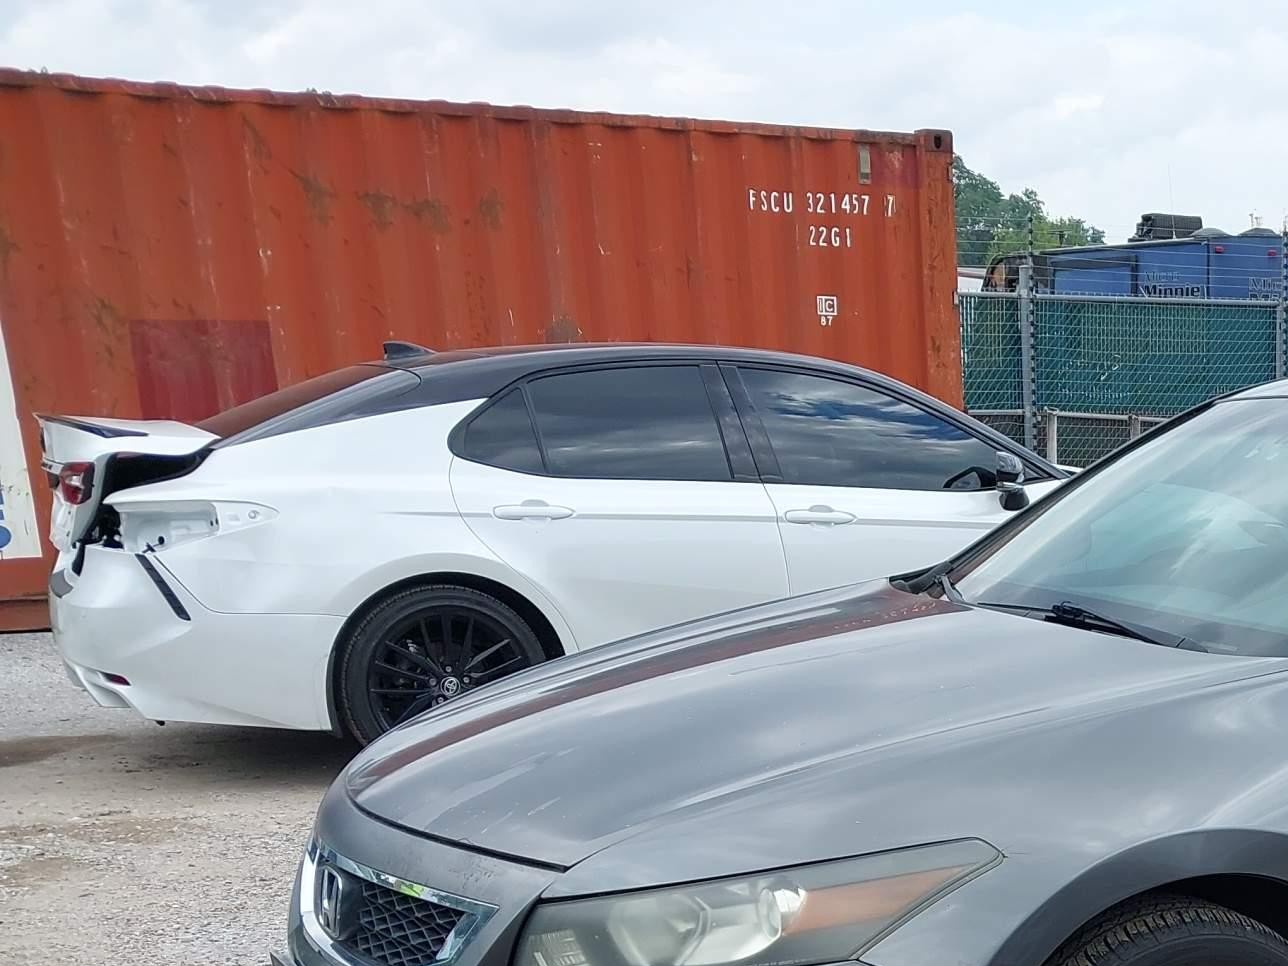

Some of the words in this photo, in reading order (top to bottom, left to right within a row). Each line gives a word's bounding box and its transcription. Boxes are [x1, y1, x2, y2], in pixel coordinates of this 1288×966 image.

[749, 189, 793, 213] FSCU
[806, 192, 870, 216] 321457
[809, 225, 850, 248] 22G1
[1144, 282, 1201, 297] Minnie
[821, 315, 833, 326] 87
